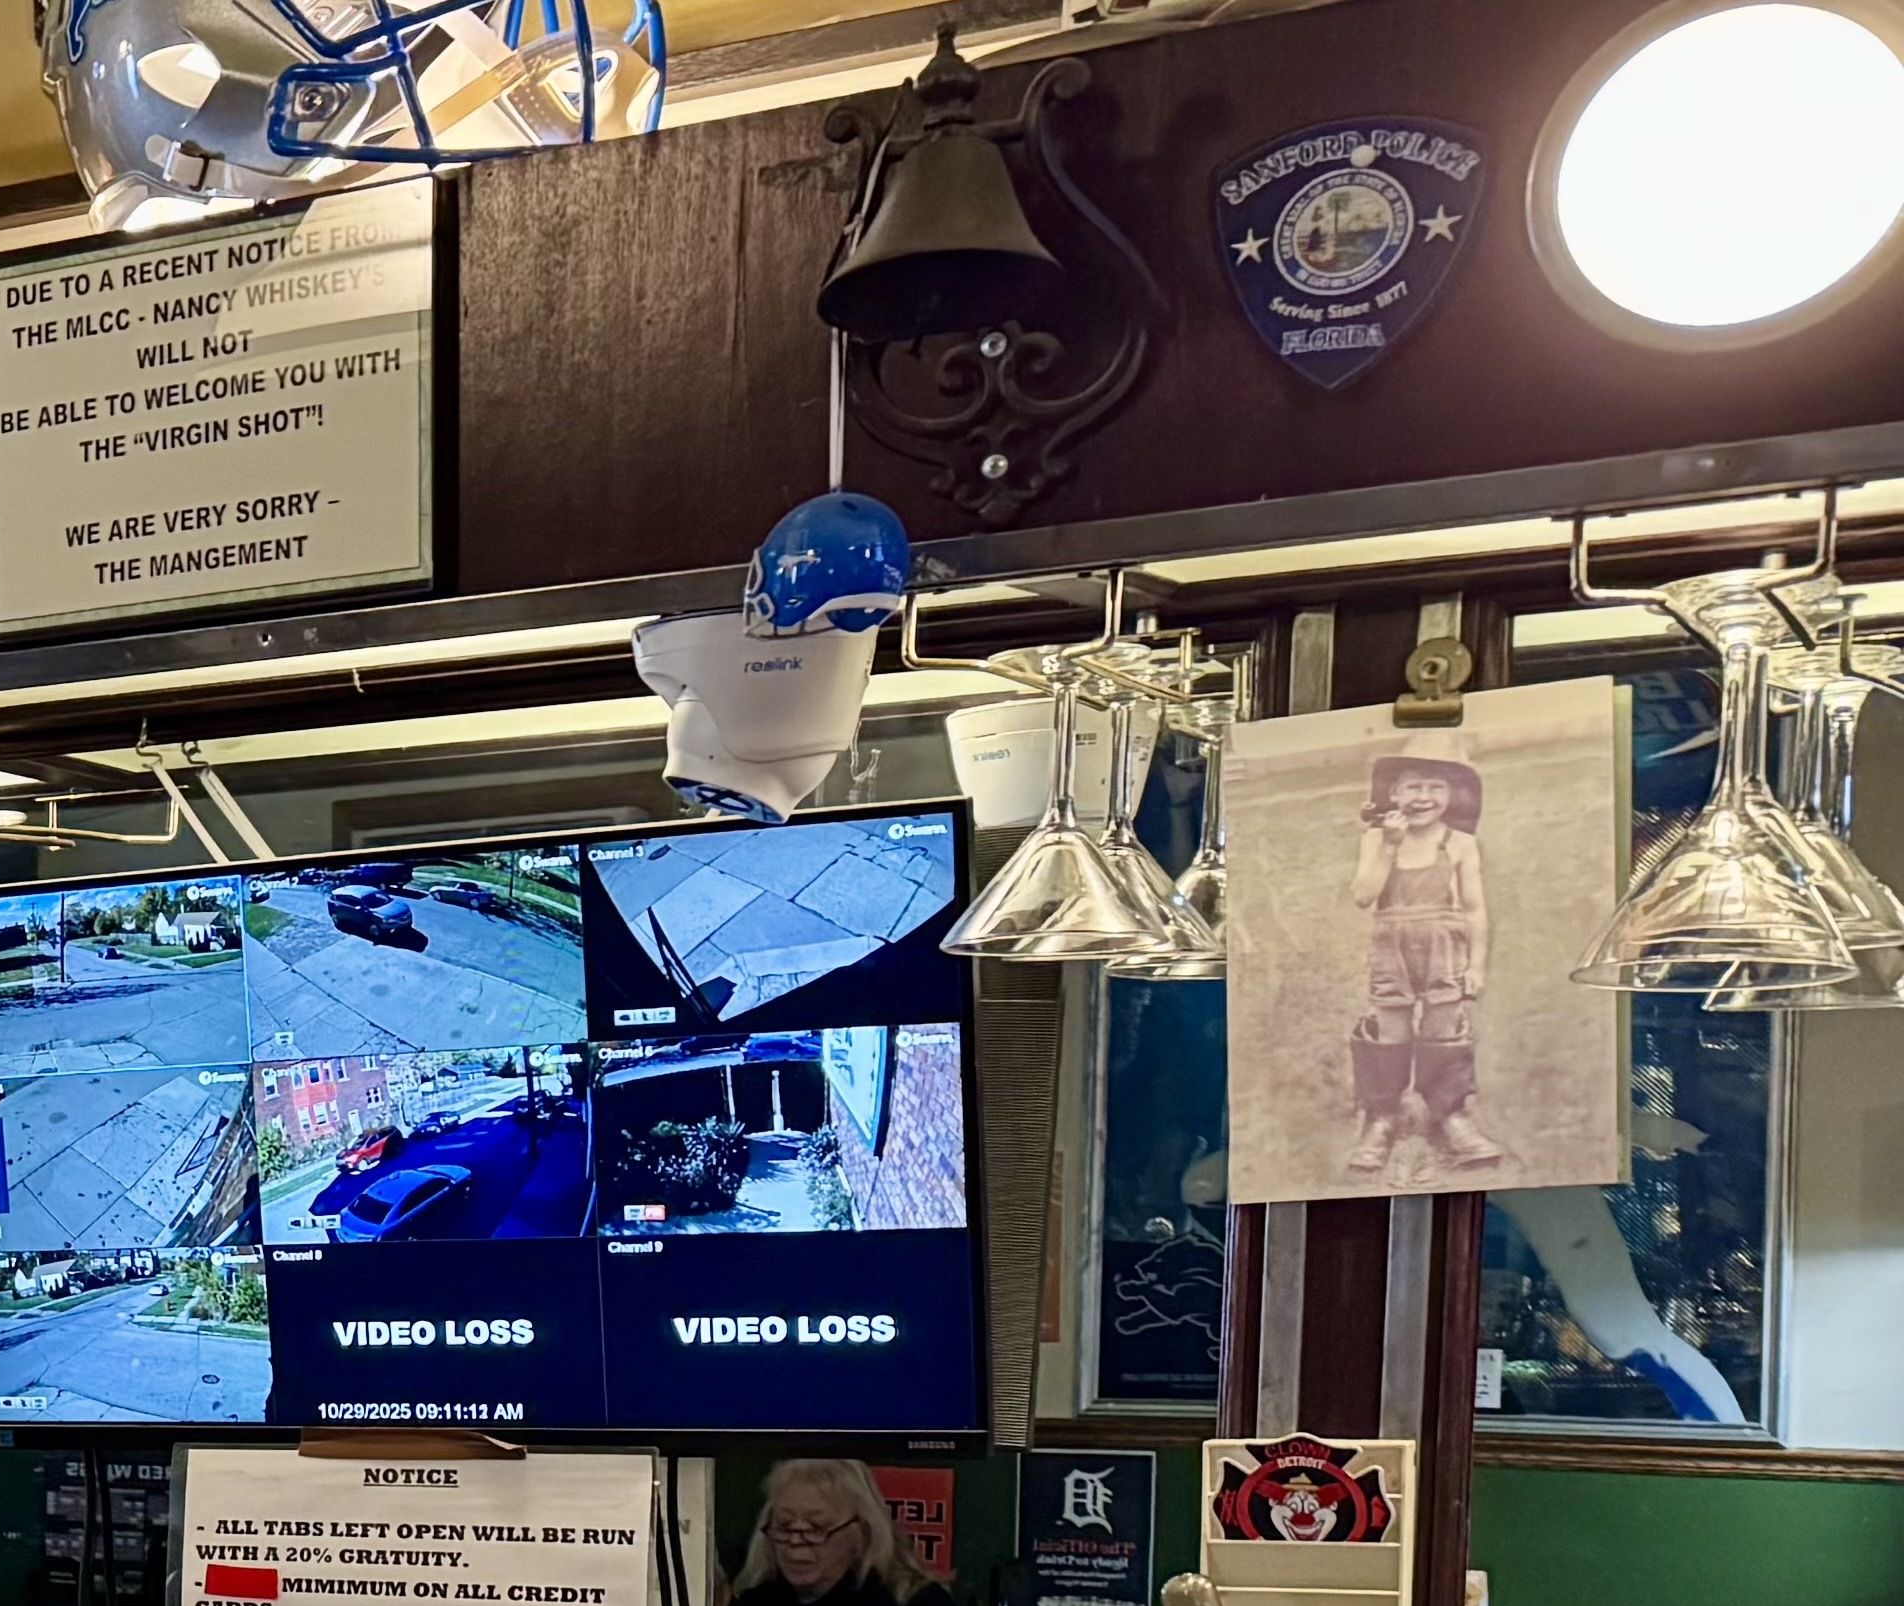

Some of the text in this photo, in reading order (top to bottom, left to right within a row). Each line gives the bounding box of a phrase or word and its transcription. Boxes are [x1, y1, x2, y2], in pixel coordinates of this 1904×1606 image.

[1220, 130, 1481, 204] SANFORD POLICE
[6, 231, 321, 309] DUE TO A RECENT NOTICE
[13, 321, 57, 349] THE
[66, 308, 130, 340] MLCC
[153, 290, 236, 325] NANCY
[137, 330, 253, 369] WILL NOT
[1281, 324, 1386, 356] FLORIDA
[1, 348, 401, 434] BE ABLE TO WELCOME YOU WITH
[80, 435, 126, 463] THE
[65, 491, 320, 547] WE ARE VERY SORRY
[95, 535, 308, 585] THE MANGEMENT
[333, 1319, 535, 1348] VIDEO LOSS
[672, 1315, 897, 1344] VIDEO LOSS
[317, 1403, 523, 1422] 10/29/2025 AM
[364, 1469, 458, 1487] NOTICE
[215, 1520, 636, 1545] ALL TABS LEFT OPEN WILL BE RUN
[196, 1545, 469, 1568] WITH A 20% GRATUITY.
[282, 1578, 605, 1603] MIMIMUM ON ALL CREDIT
